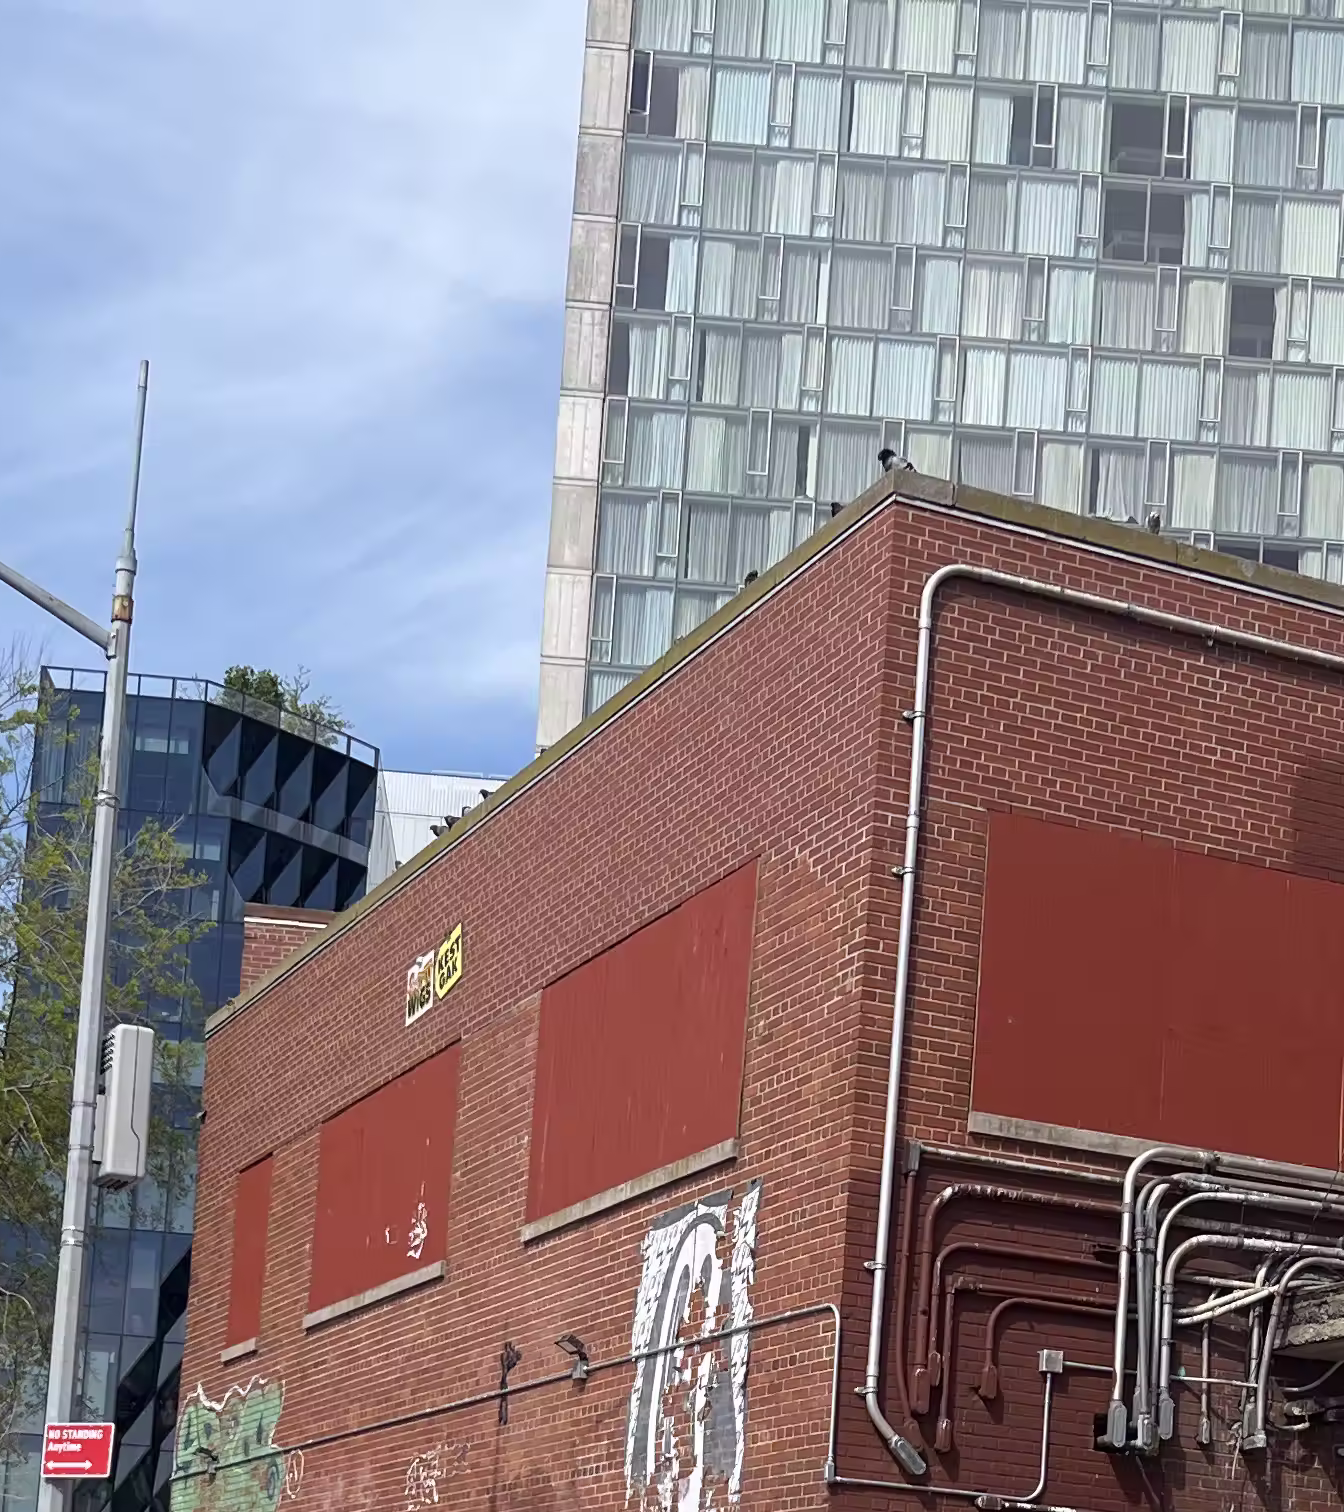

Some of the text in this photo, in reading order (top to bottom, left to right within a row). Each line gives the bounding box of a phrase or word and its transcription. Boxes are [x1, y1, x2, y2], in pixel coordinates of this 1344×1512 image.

[437, 933, 461, 974] KEST
[48, 1429, 104, 1440] NO STANDING
[47, 1441, 82, 1454] Anytime
